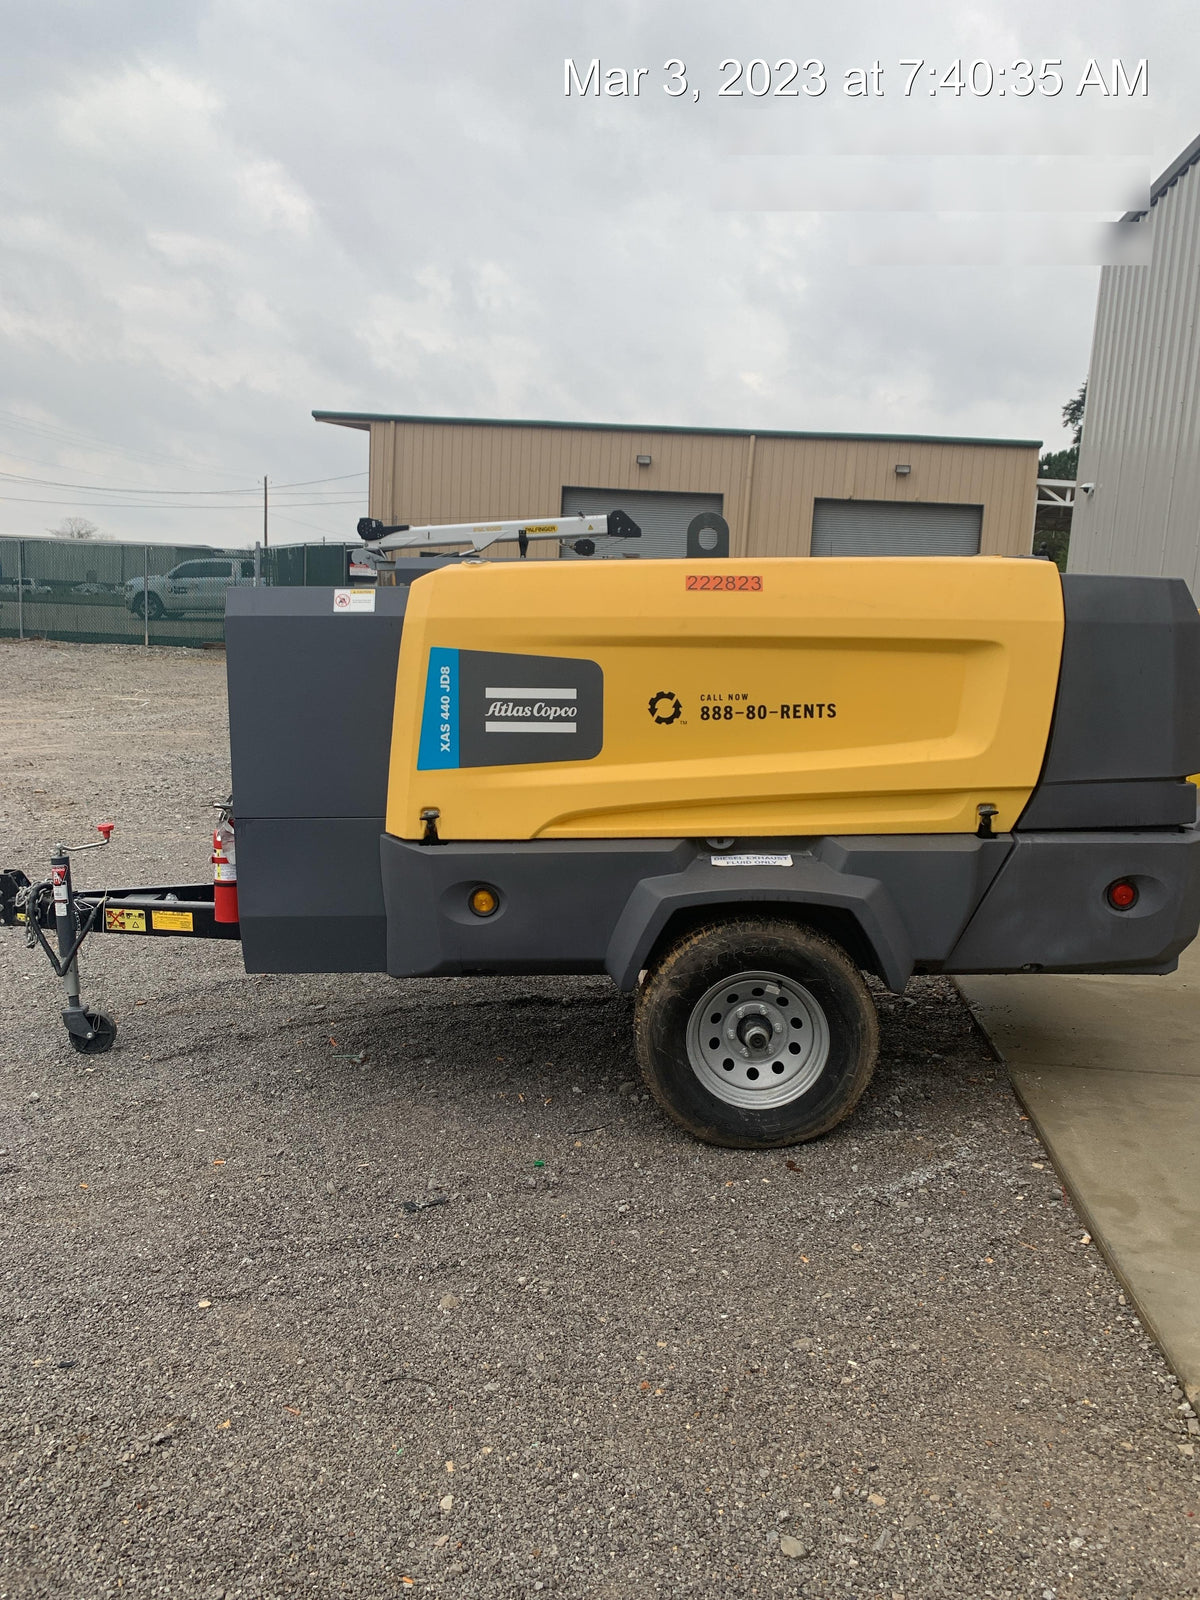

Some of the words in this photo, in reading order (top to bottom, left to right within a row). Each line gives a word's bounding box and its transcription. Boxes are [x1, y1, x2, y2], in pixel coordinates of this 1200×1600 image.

[687, 575, 762, 591] 222823
[440, 665, 451, 693] JD8
[700, 693, 724, 702] CALL
[727, 693, 749, 701] NOW
[440, 695, 451, 721] 440
[485, 701, 532, 717] Atlas
[532, 701, 577, 720] Copco
[700, 702, 837, 721] 888-80-RENTS
[440, 723, 451, 752] XAS
